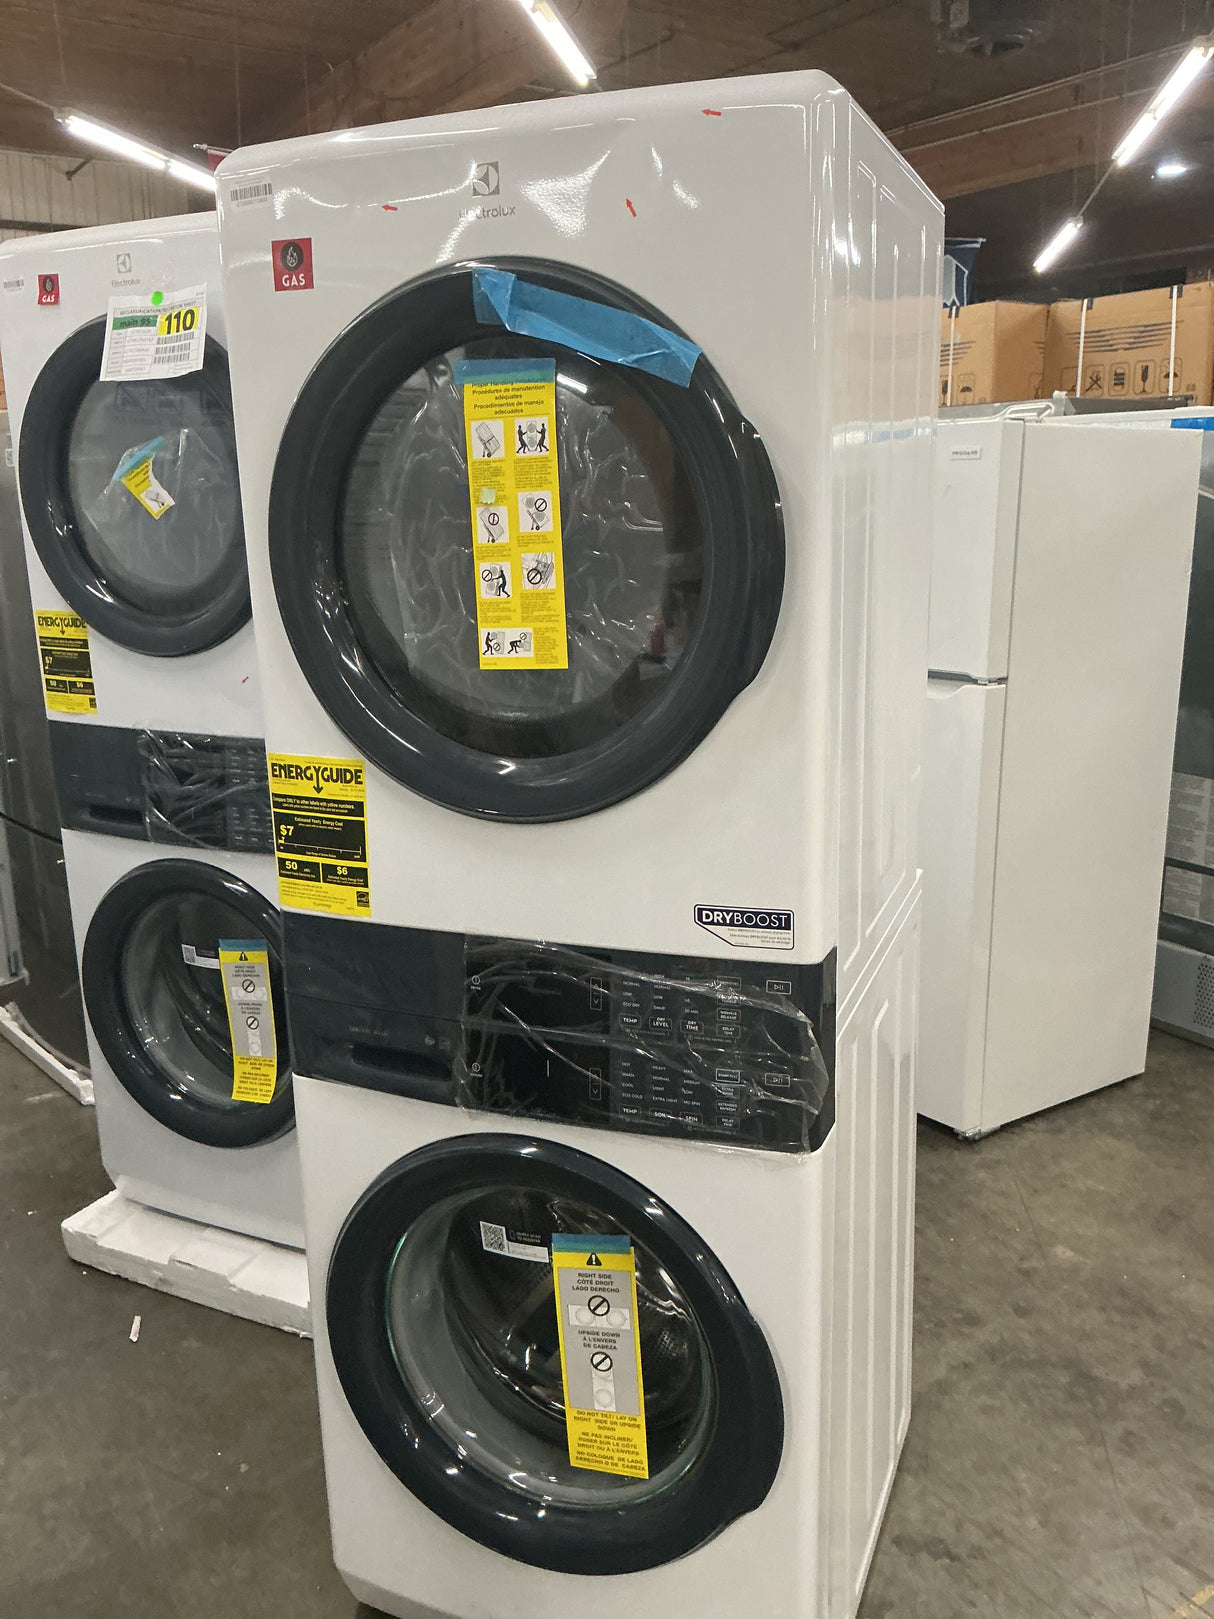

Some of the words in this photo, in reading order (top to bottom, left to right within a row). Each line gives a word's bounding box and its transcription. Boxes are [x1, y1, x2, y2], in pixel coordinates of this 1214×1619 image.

[458, 205, 516, 219] Elctrolux
[282, 273, 306, 288] GAS
[42, 294, 55, 303] GAS
[164, 308, 195, 335] 110
[472, 387, 502, 395] Procédures
[511, 384, 546, 392] manutention
[494, 393, 523, 401] adéquates
[473, 401, 515, 410] Procedimientos
[494, 408, 524, 416] adecuados
[270, 762, 363, 785] ENERGYGUIDE
[280, 824, 294, 836] $7
[285, 861, 298, 870] 50
[336, 866, 348, 875] $6
[702, 910, 788, 928] DRYBOOST
[597, 1424, 616, 1432] DOWN
[619, 1421, 641, 1429] UPSIDE
[575, 1455, 604, 1465] DERECHO
[621, 1463, 646, 1471] CABEZA
[626, 1457, 643, 1465] LADO
